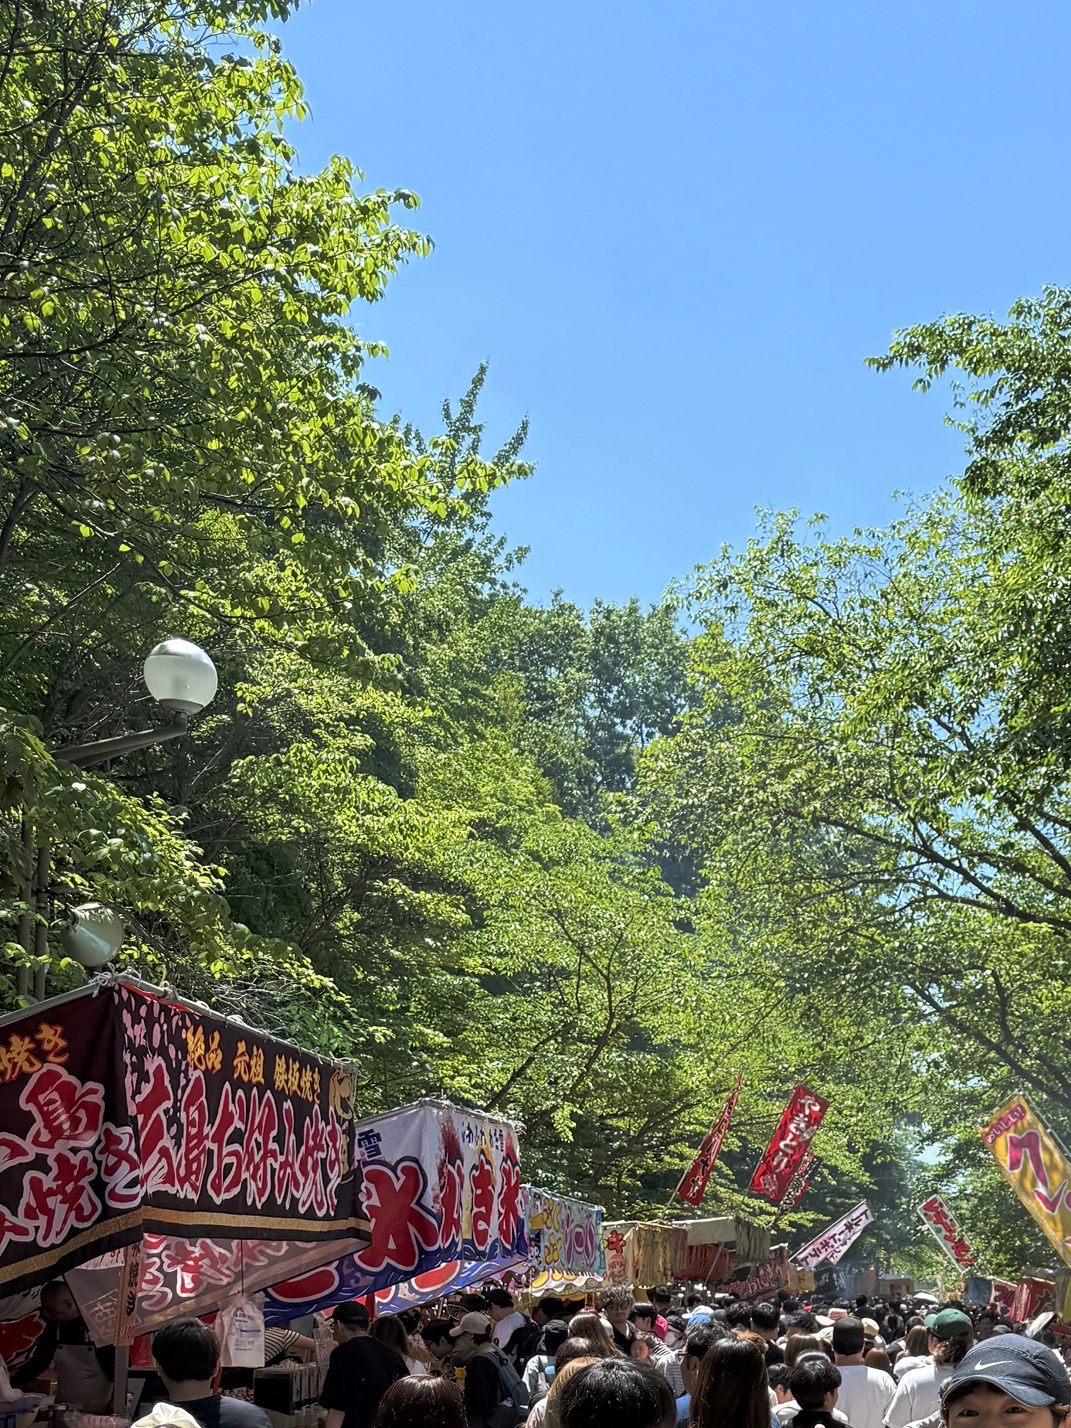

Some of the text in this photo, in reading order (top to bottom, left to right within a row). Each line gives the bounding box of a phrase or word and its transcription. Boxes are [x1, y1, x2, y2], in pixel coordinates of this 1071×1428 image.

[233, 1040, 265, 1085] 元祖
[273, 1054, 321, 1105] 鉄板焼き
[135, 1056, 344, 1218] 広島お好み焼き
[772, 1094, 821, 1173] やきとり
[801, 1208, 869, 1266] トルネードポテト
